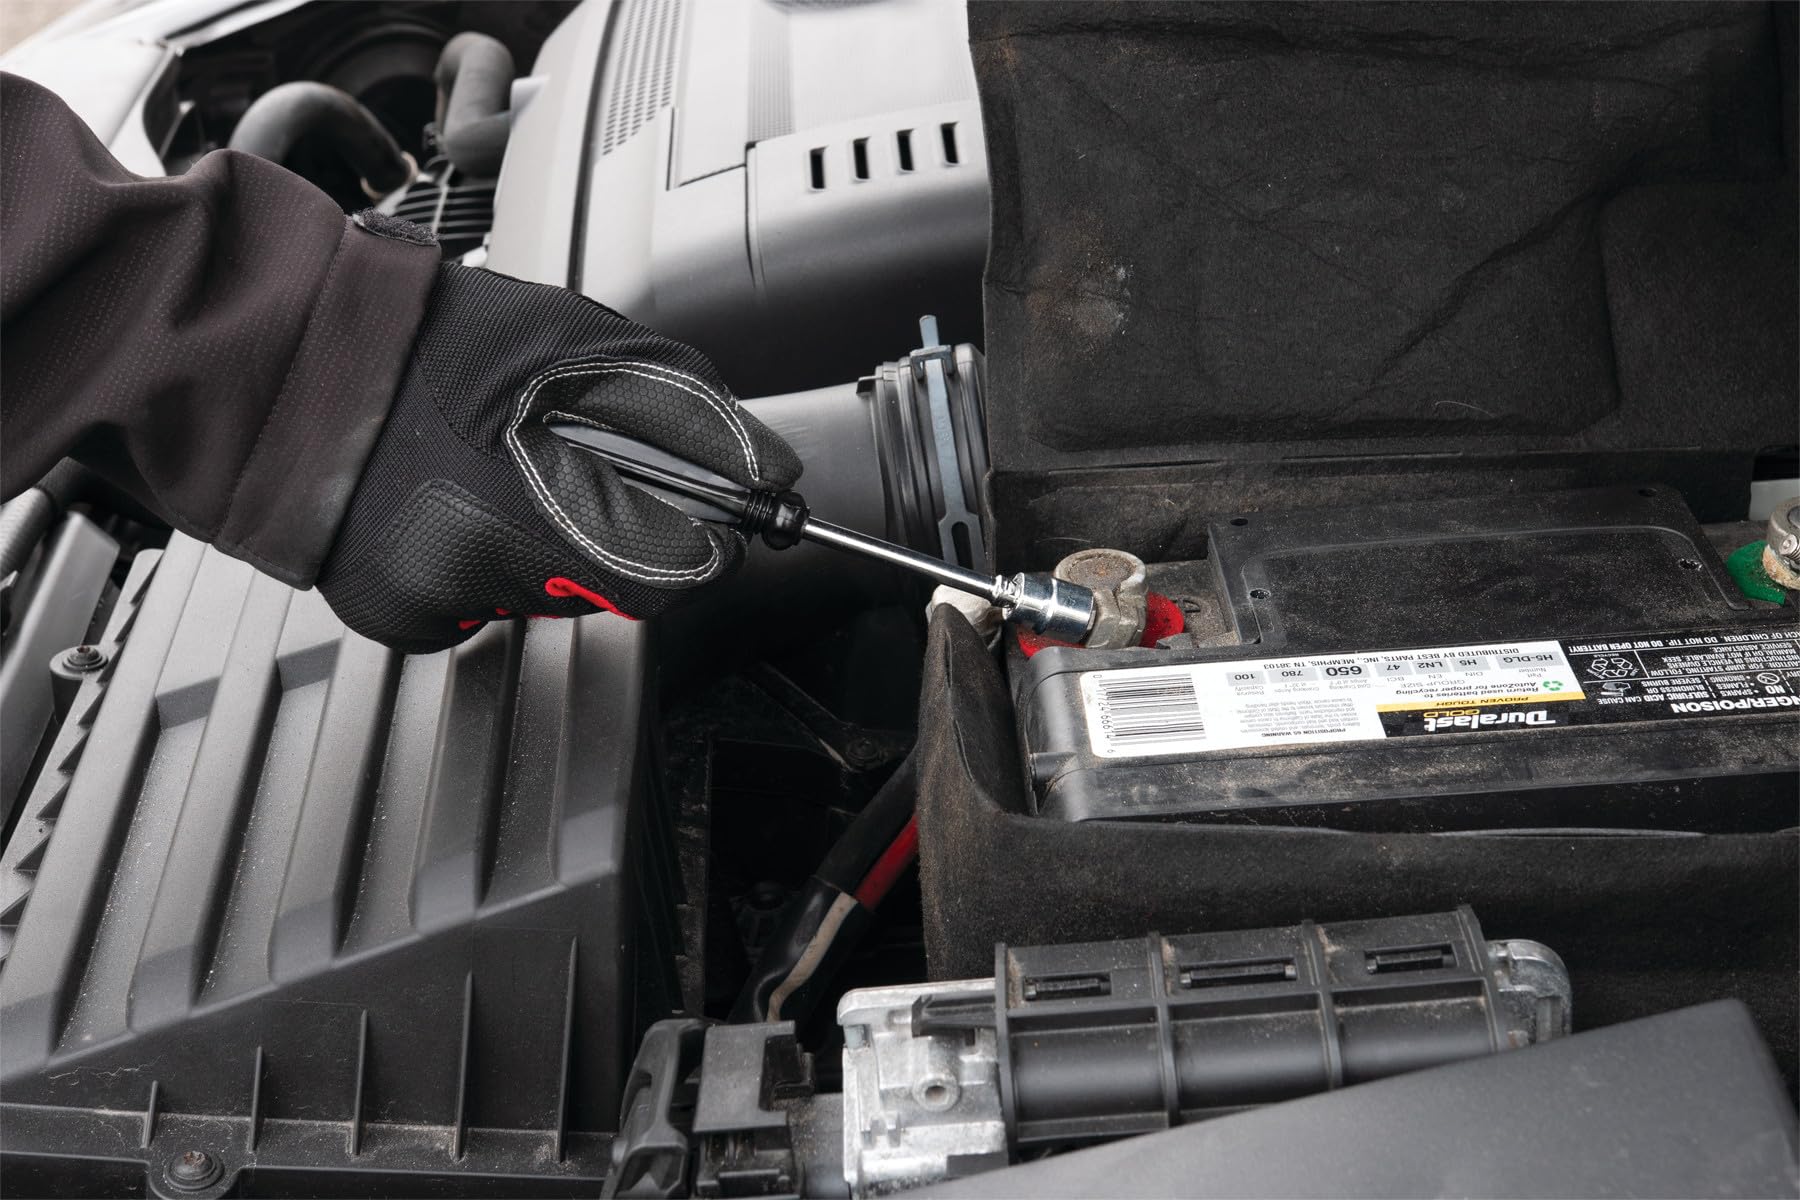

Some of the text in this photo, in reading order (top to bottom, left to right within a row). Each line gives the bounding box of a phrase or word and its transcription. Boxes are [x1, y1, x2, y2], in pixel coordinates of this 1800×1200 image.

[1568, 644, 1608, 652] BATTERY!
[1609, 642, 1632, 650] OPEN
[1458, 648, 1519, 658] DISTRIBUTED
[1308, 658, 1355, 666] MEMPHIS,
[1503, 654, 1554, 663] H5-DLG
[1700, 658, 1734, 666] VEHICLE
[1666, 660, 1700, 668] OWNERS
[1326, 666, 1362, 676] 650
[1668, 677, 1701, 686] SEVERE
[1709, 674, 1745, 683] SMOKING
[1660, 684, 1705, 694] BLINDNESS
[1715, 681, 1748, 690] FLAMES
[1764, 684, 1785, 694] NO
[1666, 690, 1709, 700] SULFURIC
[1720, 688, 1753, 696] SPARKS
[1624, 696, 1642, 704] CAN
[1643, 694, 1664, 702] ACID
[1423, 709, 1480, 718] GOLD
[1424, 710, 1556, 732] Duralast
